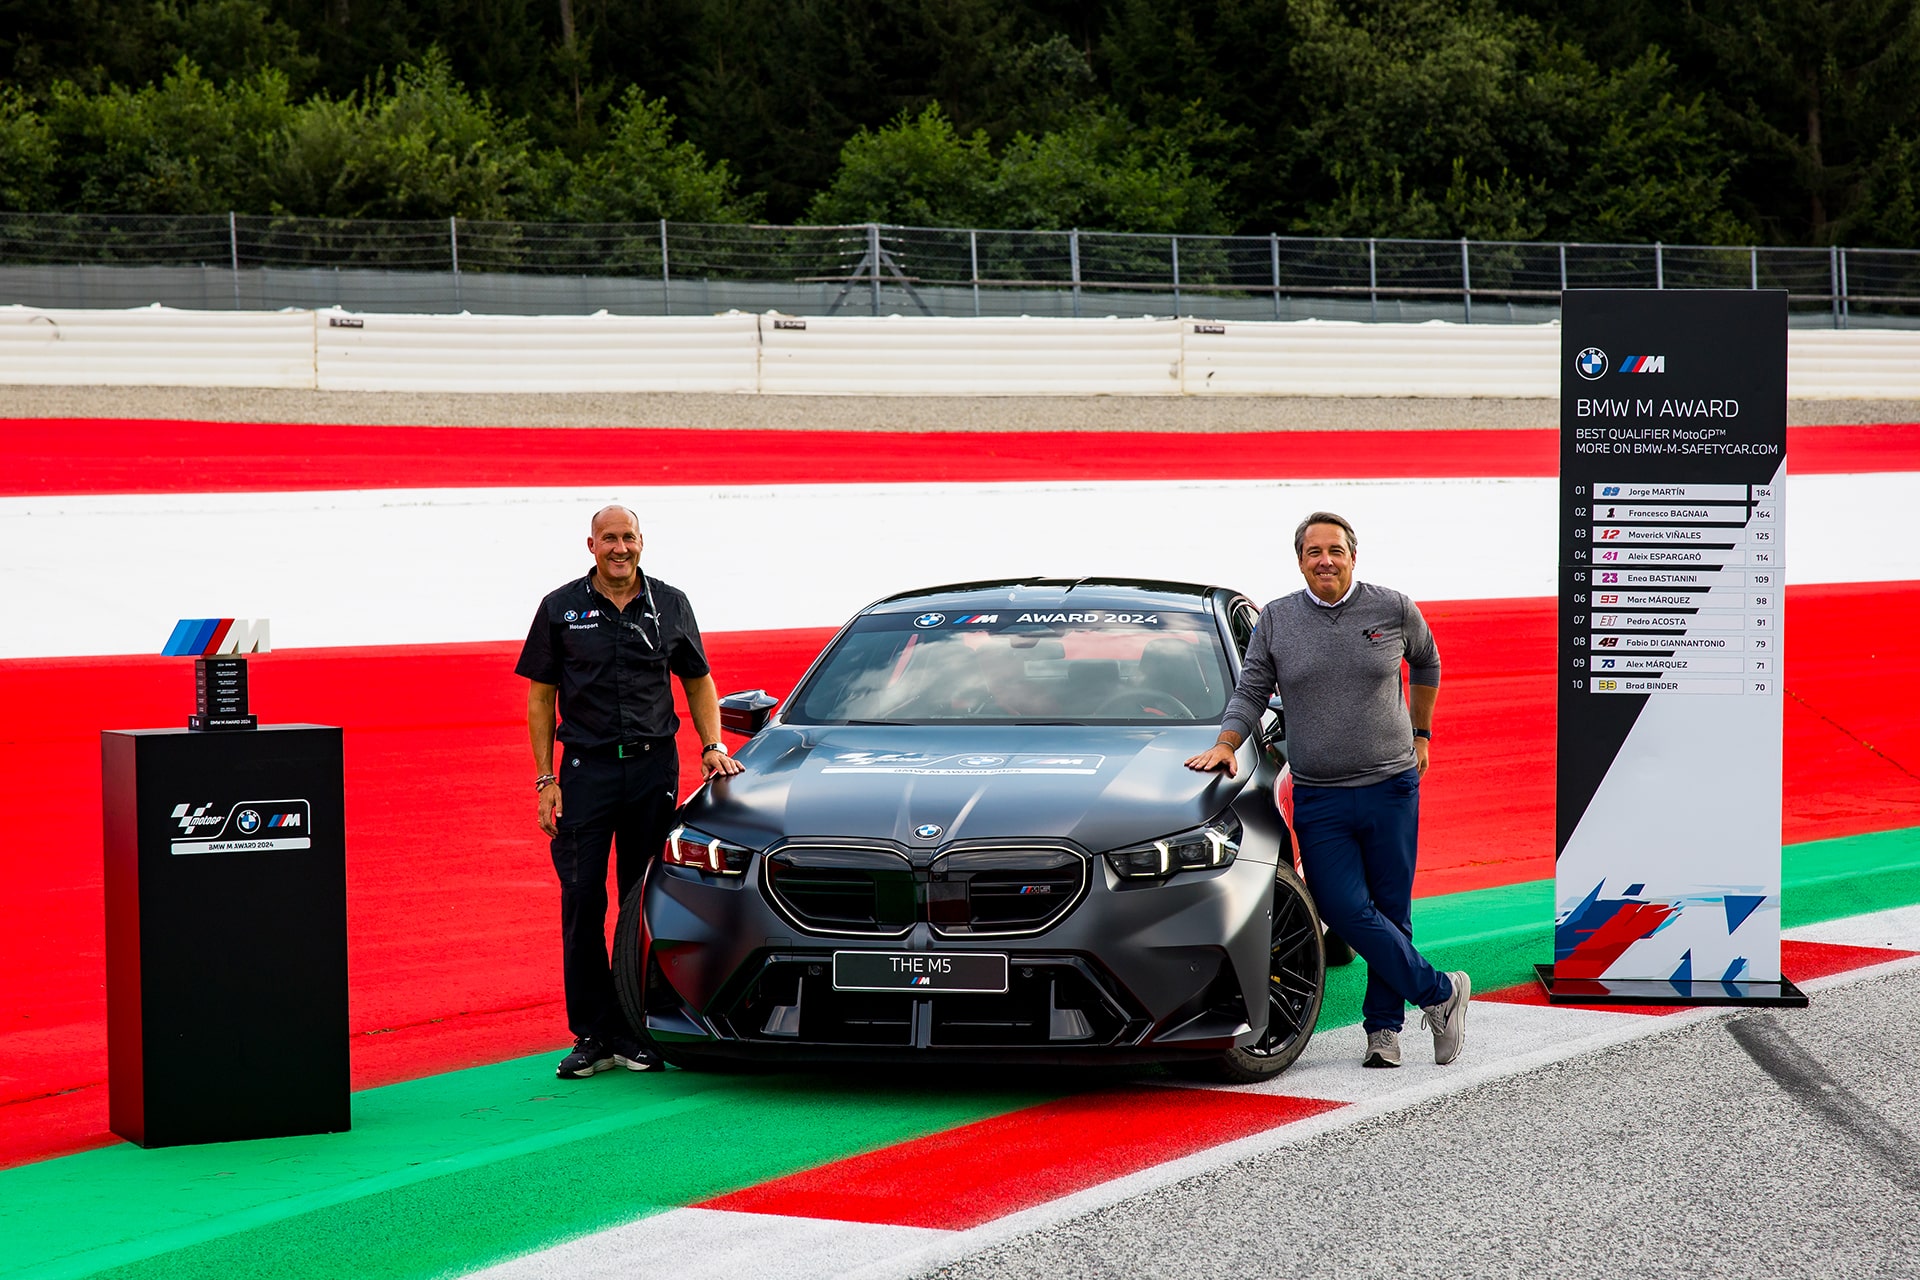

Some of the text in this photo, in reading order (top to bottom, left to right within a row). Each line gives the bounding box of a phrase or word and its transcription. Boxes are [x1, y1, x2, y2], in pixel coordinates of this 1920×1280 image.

[1576, 399, 1739, 418] BMW M AWARD
[1576, 428, 1606, 439] BEST
[1608, 429, 1670, 440] QUALIFIER
[1576, 443, 1778, 455] MORE ON BMW-M-SAFETYCAR.COM
[1575, 486, 1771, 497] 01 89 Jorge MARTÍN 184
[1574, 507, 1587, 516] 02
[1606, 507, 1615, 518] 1
[1628, 509, 1669, 518] Francesco
[1670, 509, 1709, 518] BAGNAIA
[1574, 529, 1586, 538] 03
[1601, 529, 1620, 540] 12
[1628, 531, 1664, 539] Maverick
[1665, 530, 1701, 540] VIÑALES
[1574, 551, 1769, 562] 04 41 Aleix ESPARGARÓ 114
[1574, 572, 1586, 581] 05
[1602, 572, 1618, 583] 23
[1649, 575, 1697, 583] BASTIANINI
[1573, 594, 1767, 605] 06 93 Marc MÁRQUEZ 98
[1016, 613, 1158, 624] AWARD 2024
[1573, 615, 1585, 625] 07
[1627, 617, 1650, 626] Pedro
[1651, 617, 1686, 626] ACOSTA
[1756, 619, 1766, 627] 91
[569, 622, 599, 630] Motorsport
[1573, 637, 1766, 648] 08 49 Fabio DI GIANNANTONIO 79
[1573, 658, 1585, 668] 09
[1601, 659, 1616, 668] 73
[1626, 660, 1644, 668] Alex
[1645, 660, 1688, 669] MÁRQUEZ
[1572, 680, 1583, 689] 10
[1598, 680, 1617, 691] 33
[1626, 682, 1645, 690] Brad
[1647, 682, 1679, 690] BINDER
[208, 843, 226, 851] BMW
[234, 842, 256, 850] AWARD
[889, 957, 952, 973] THE M5
